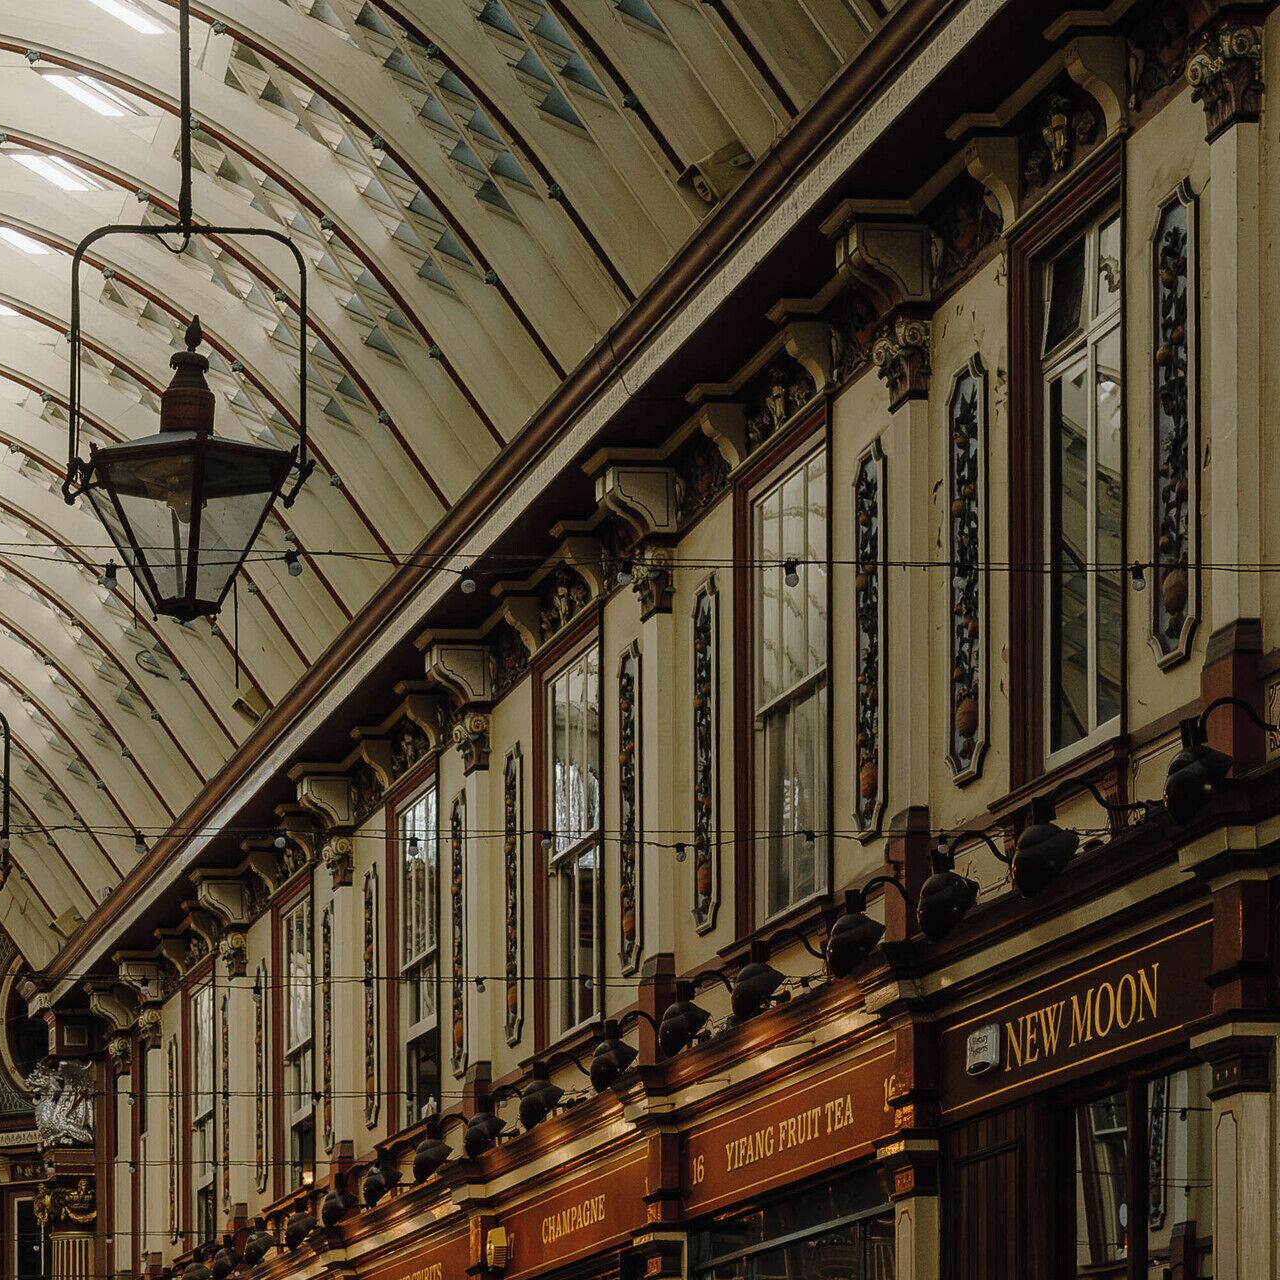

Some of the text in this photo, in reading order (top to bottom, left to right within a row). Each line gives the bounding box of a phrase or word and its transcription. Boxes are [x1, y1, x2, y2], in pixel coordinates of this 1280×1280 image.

[1004, 962, 1162, 1074] NEW MOON
[692, 1154, 705, 1186] 16
[725, 1126, 776, 1172] YIFANG
[778, 1106, 822, 1152] FRUIT
[825, 1094, 855, 1134] TEA
[541, 1194, 606, 1245] CHAMPAGNE
